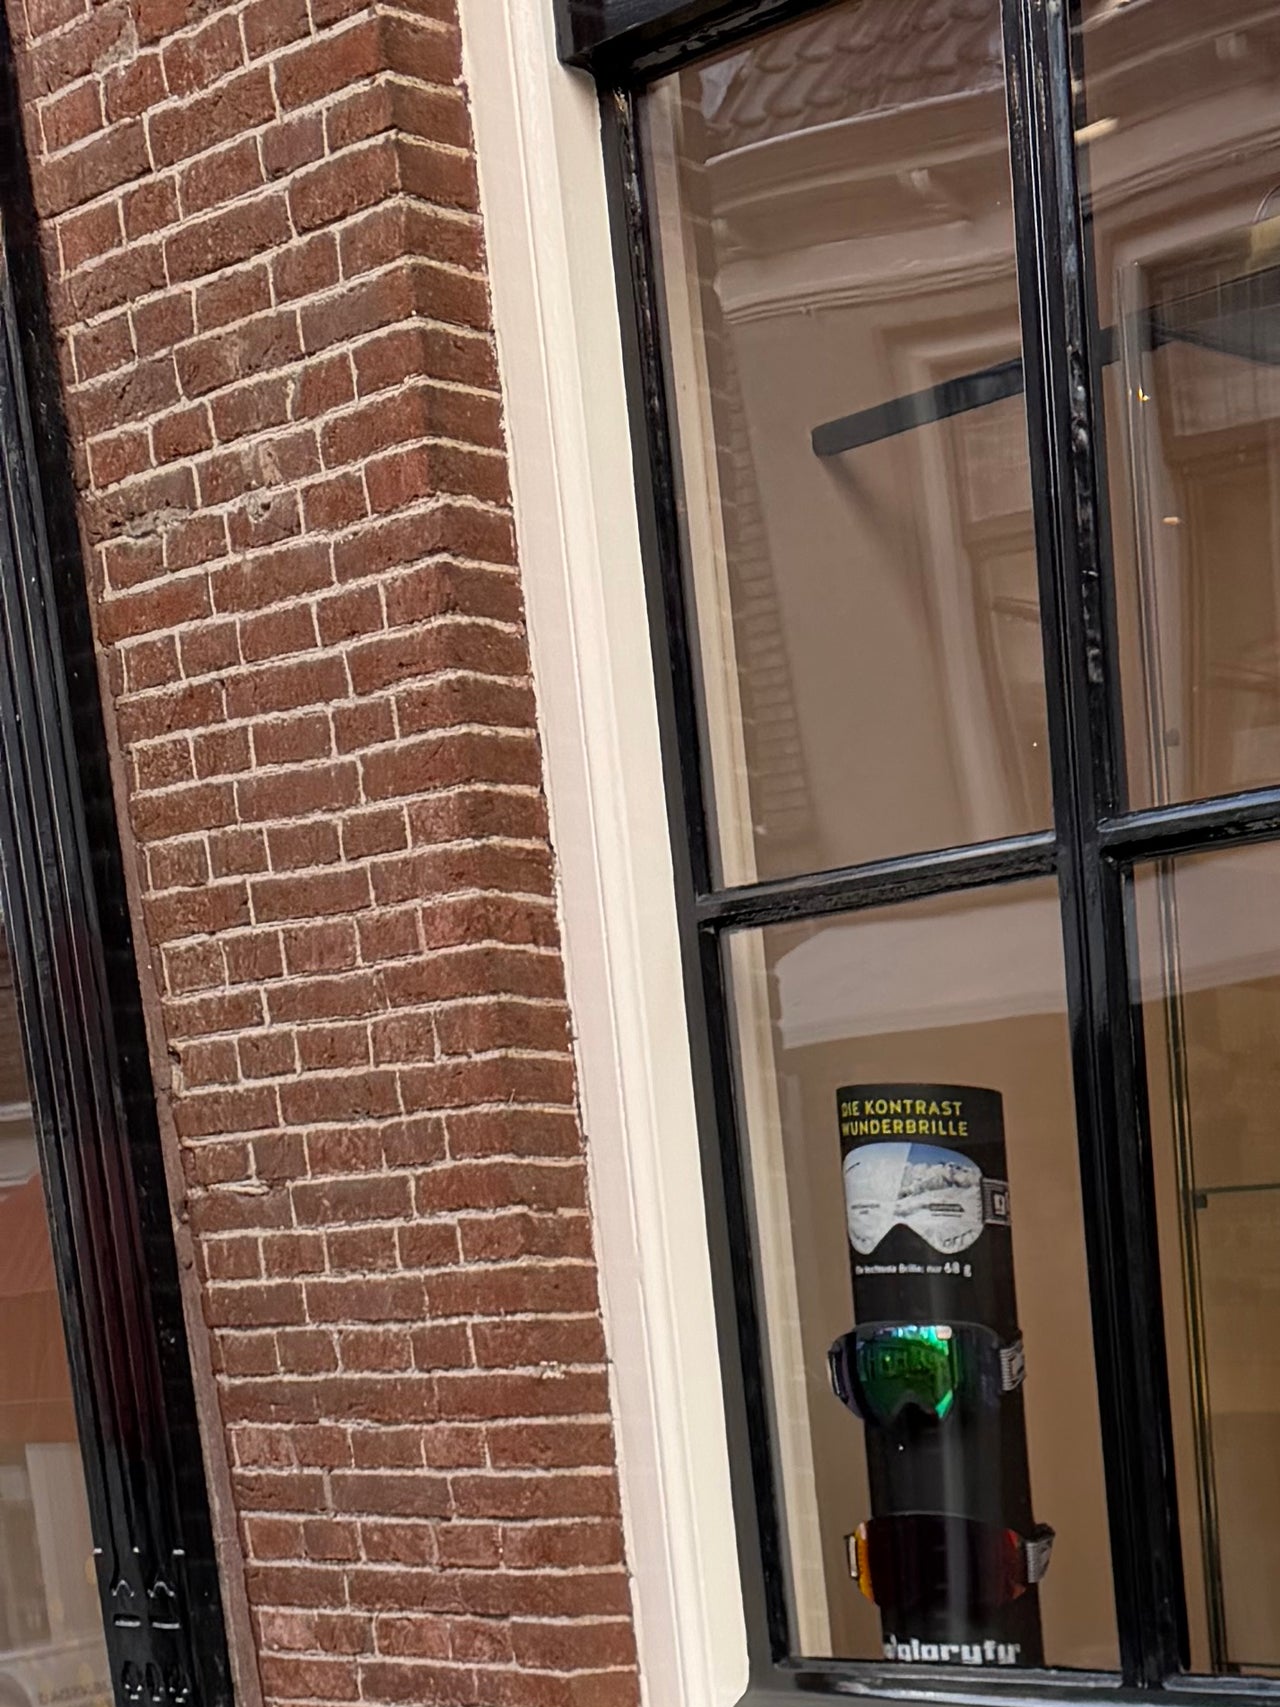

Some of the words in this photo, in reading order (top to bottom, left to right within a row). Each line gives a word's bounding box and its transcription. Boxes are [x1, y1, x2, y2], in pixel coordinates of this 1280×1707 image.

[841, 1101, 860, 1117] DIE
[864, 1099, 962, 1116] KONTRAST
[841, 1119, 968, 1136] WUNDERBRILLE
